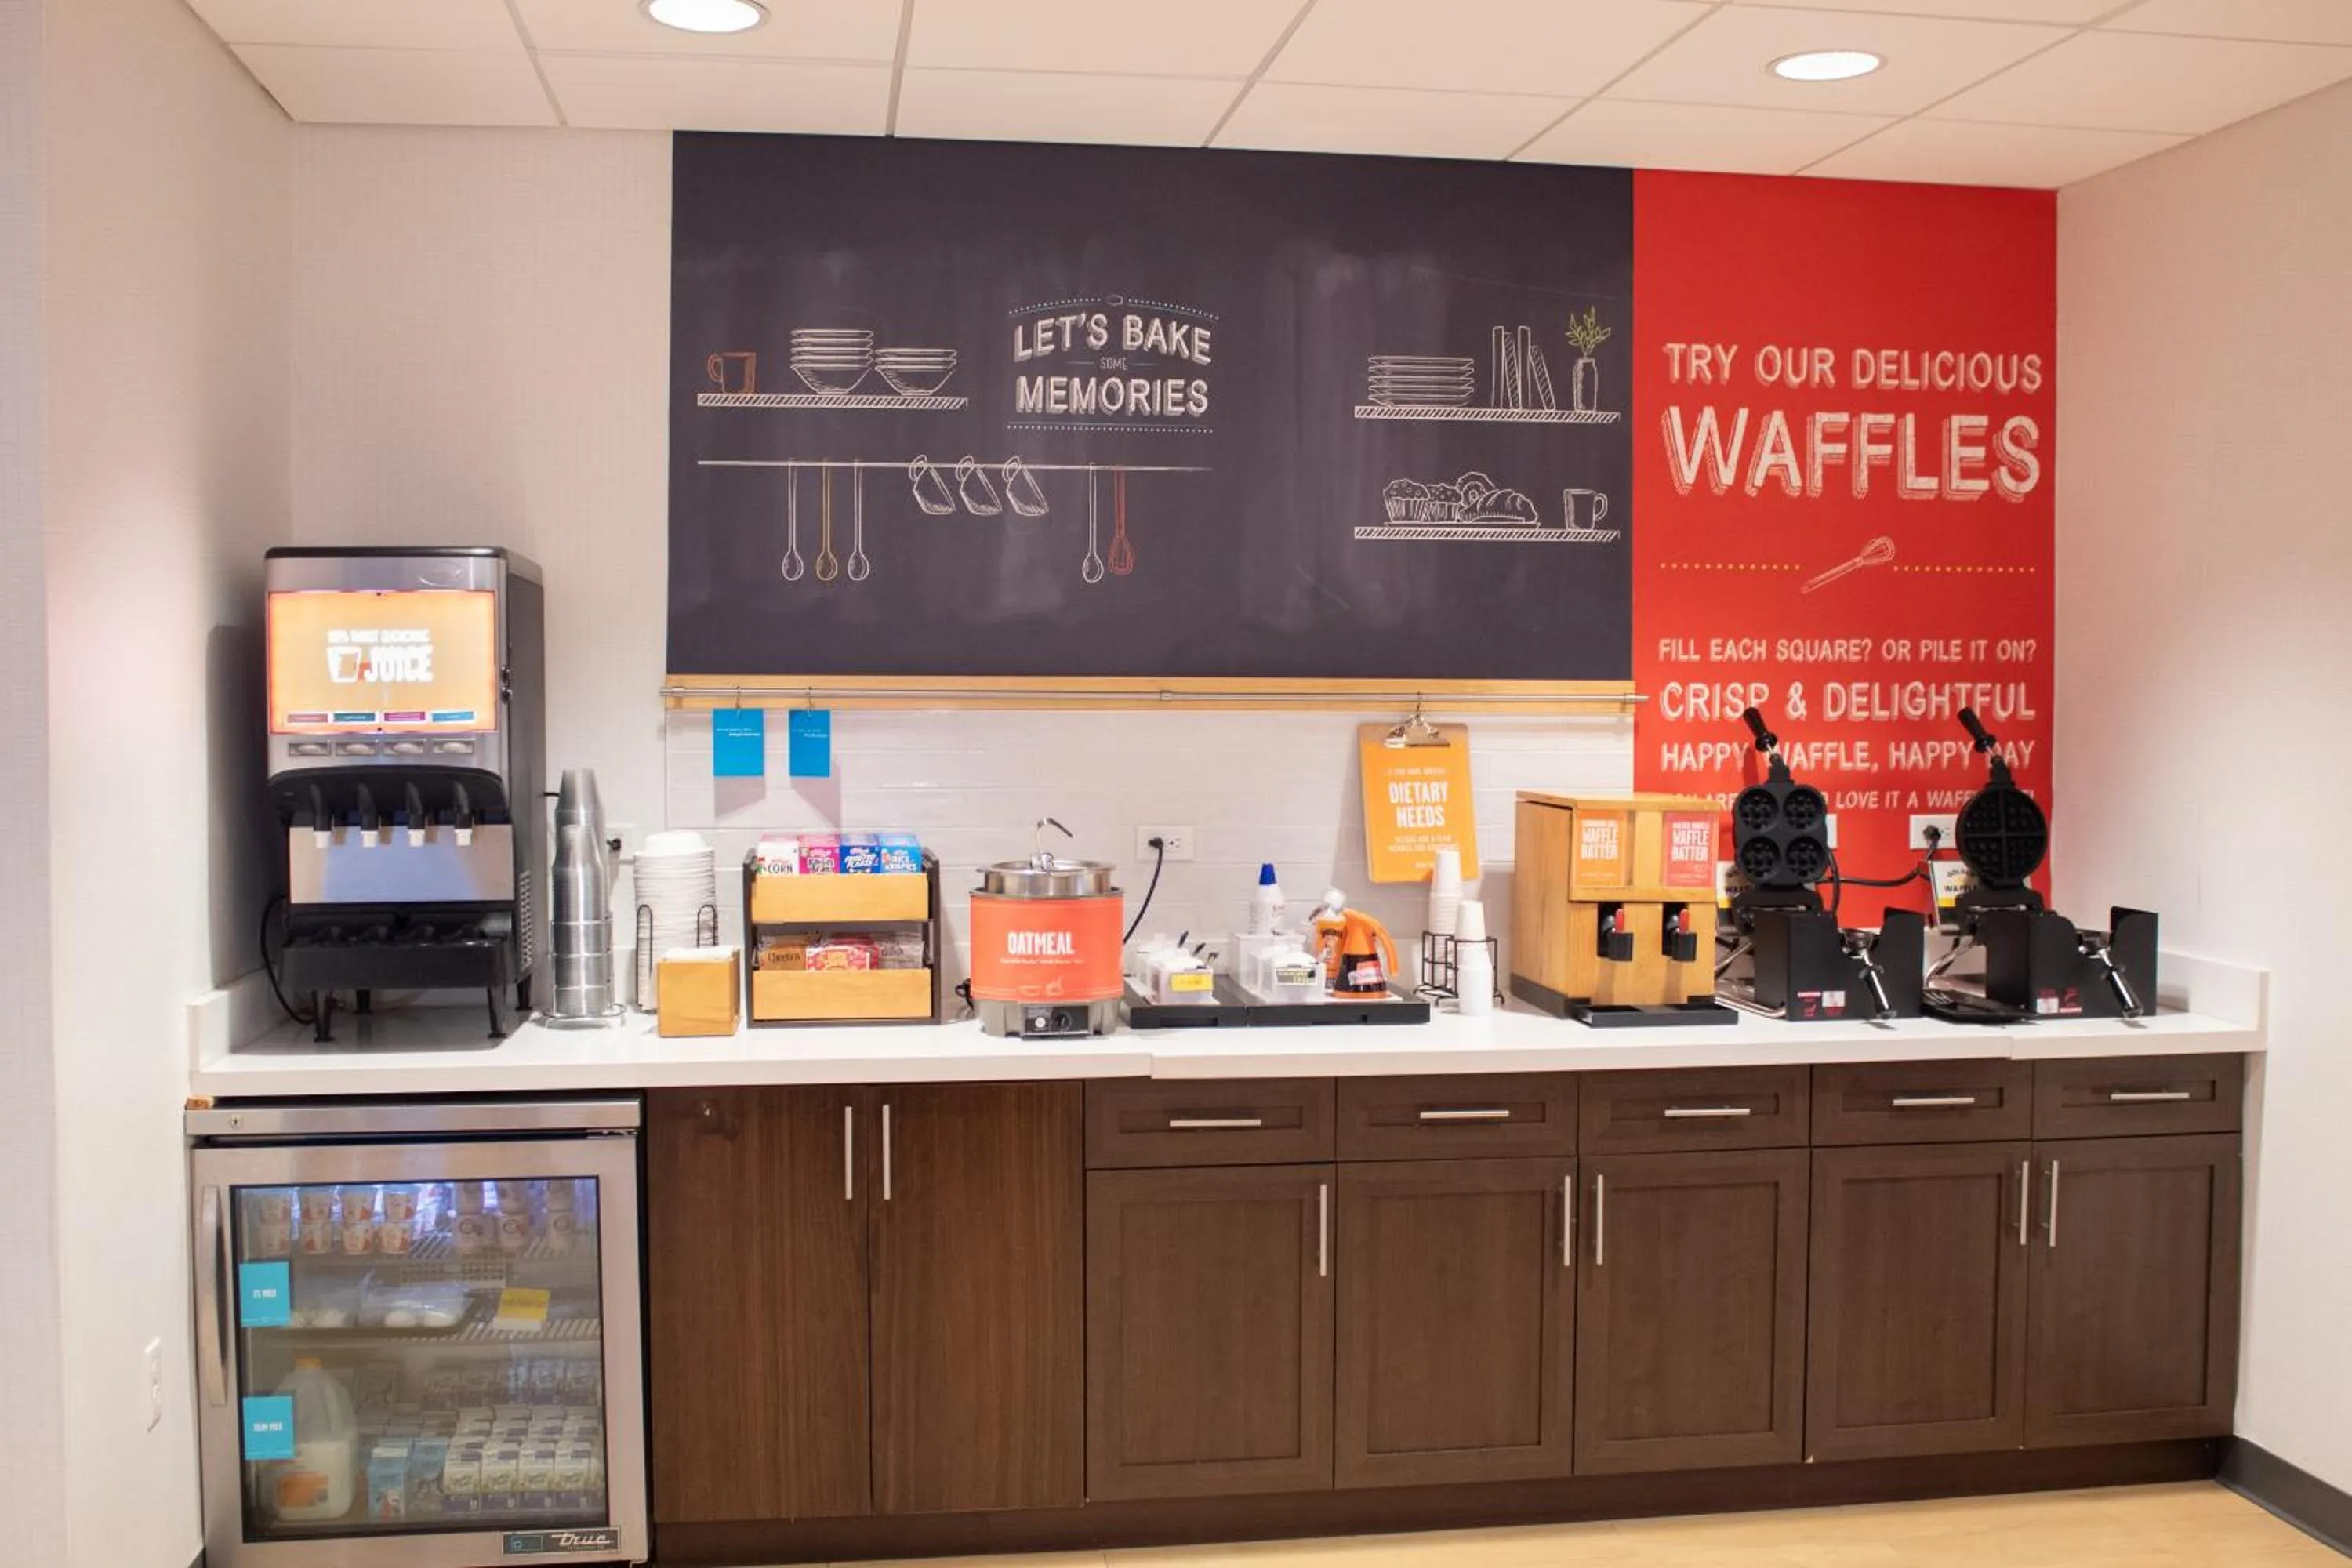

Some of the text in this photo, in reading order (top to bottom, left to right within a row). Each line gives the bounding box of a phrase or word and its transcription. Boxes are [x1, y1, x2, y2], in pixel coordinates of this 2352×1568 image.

[1014, 312, 1212, 366] LET'S BAKE
[1099, 356, 1128, 371] SOME
[1662, 343, 2042, 395] TRY OUR DELICIOUS
[1015, 376, 1209, 418] MEMORIES
[1660, 405, 2041, 503] WAFFLES
[1658, 638, 2037, 662] FILL EACH SQUARE? OR PILE IT ON?
[364, 644, 434, 684] JUICE
[1659, 681, 2036, 722] CRISP & DELIGHTFUL
[1661, 742, 1750, 772] HAPPY
[1889, 740, 1974, 771] HAPPY
[1388, 781, 1448, 804] DIETARY
[1836, 790, 1879, 809] LOVE
[1884, 790, 1901, 808] IT
[1906, 790, 1918, 809] A
[1396, 806, 1445, 828] NEEDS
[1582, 828, 1619, 844] WAFFLE
[1672, 829, 1709, 846] WAFFLE
[1580, 844, 1618, 860] BATTER
[1671, 846, 1708, 862] BATTER
[768, 862, 793, 873] CORN
[1007, 931, 1075, 955] OATMEAL
